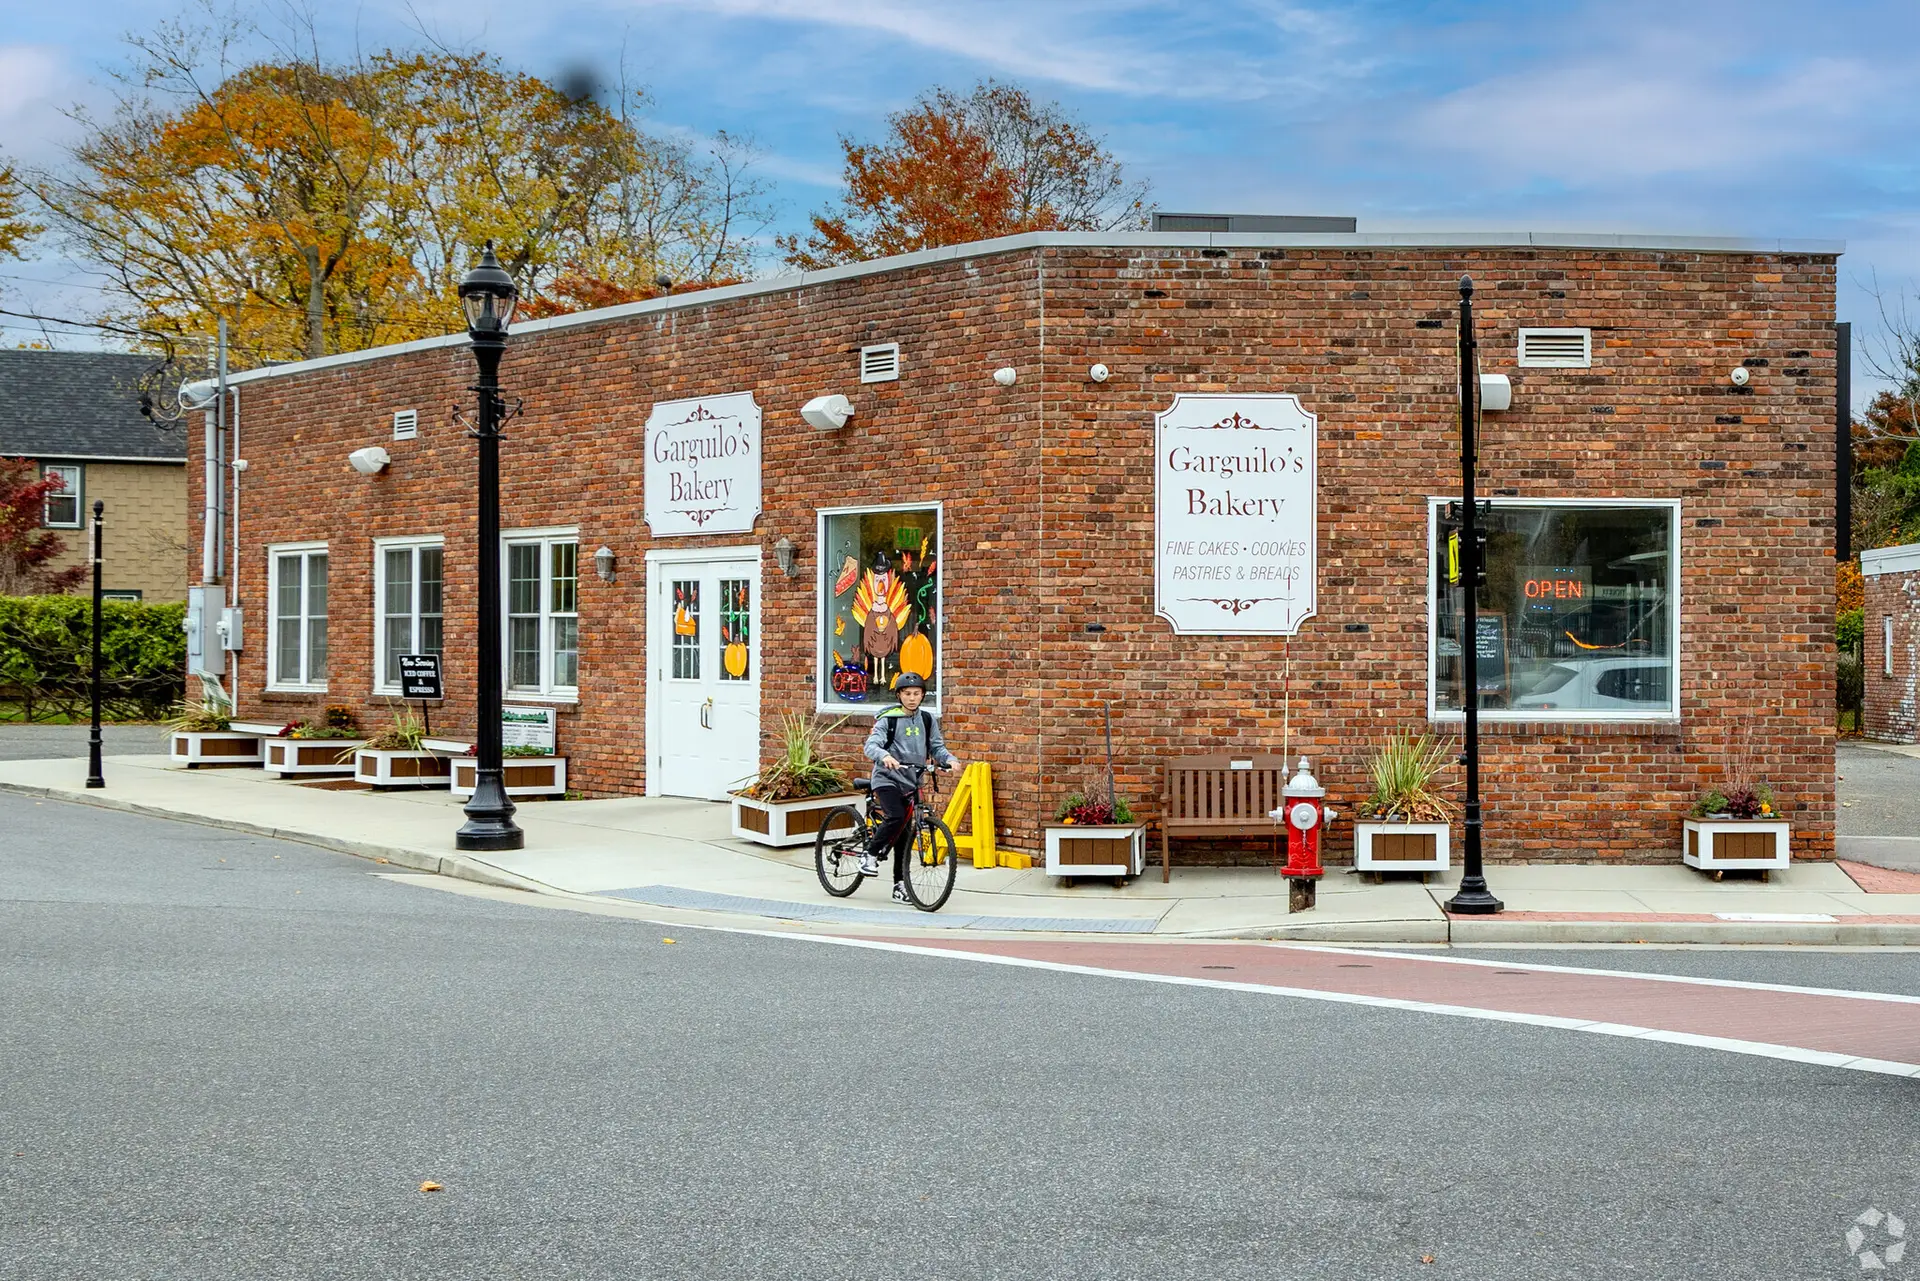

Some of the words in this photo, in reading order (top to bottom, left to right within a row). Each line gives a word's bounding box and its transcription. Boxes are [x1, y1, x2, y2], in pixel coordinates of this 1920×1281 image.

[653, 421, 751, 469] Garguilo's
[1168, 446, 1304, 480] Garguilo's
[669, 470, 734, 506] Bakery
[1185, 488, 1286, 523] Bakery
[1165, 541, 1195, 556] FINE
[1198, 541, 1240, 556] CAKES
[1251, 541, 1307, 556] COOKIES
[1172, 566, 1232, 581] PASTRIES
[1235, 566, 1245, 581] &
[1249, 566, 1301, 581] BREADS
[1524, 580, 1583, 599] OPEN
[401, 657, 415, 667] Now
[415, 657, 435, 669] Serving
[416, 670, 436, 678] COFFEE
[833, 672, 868, 693] OPEN
[409, 686, 435, 694] ESPRESSO
